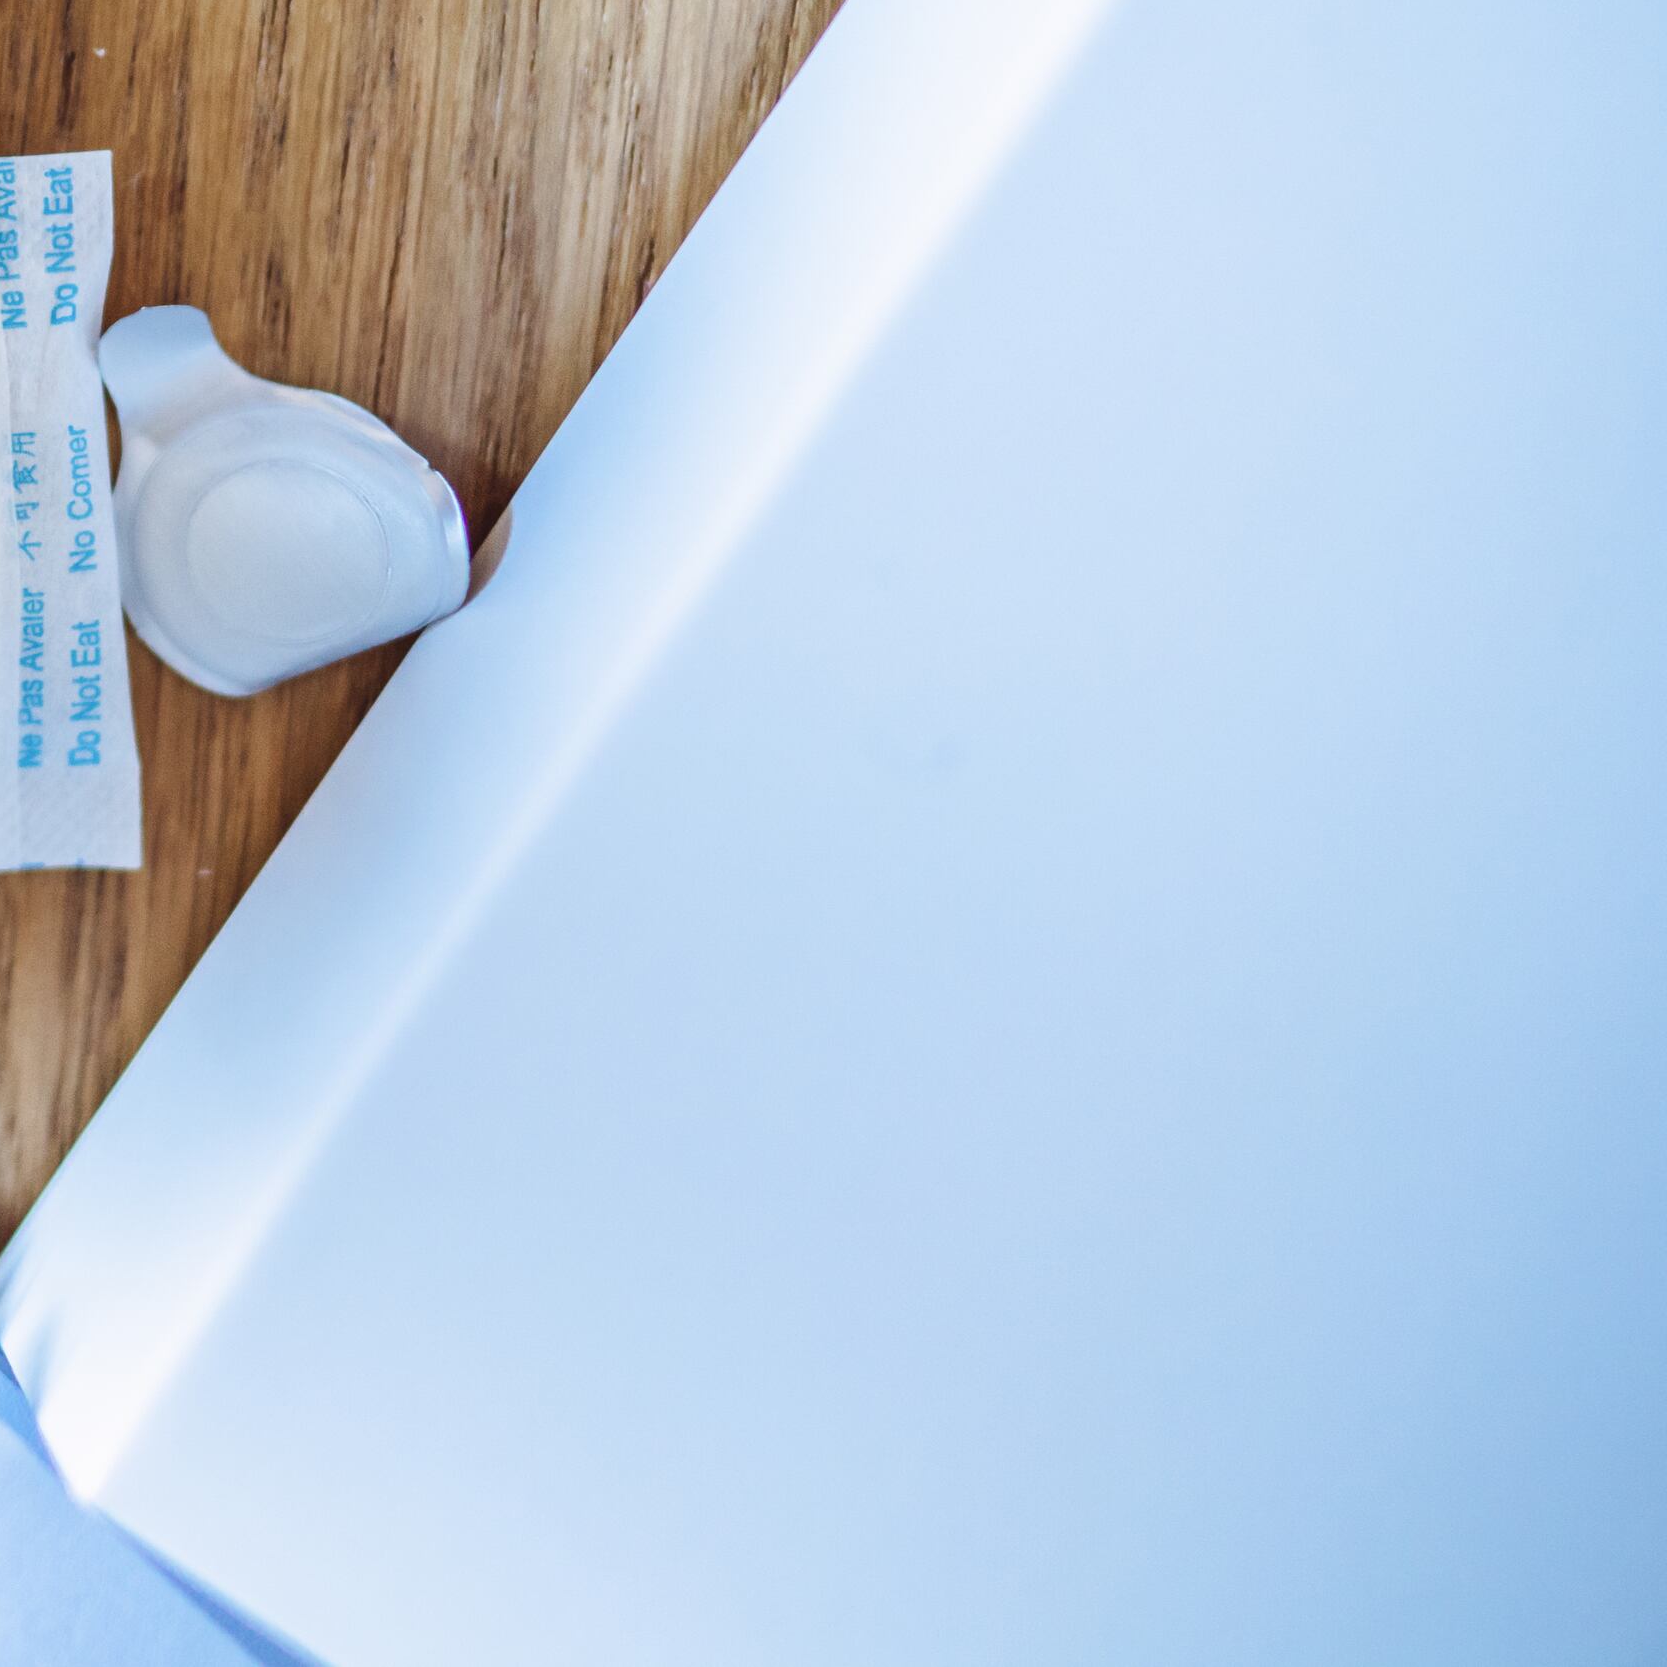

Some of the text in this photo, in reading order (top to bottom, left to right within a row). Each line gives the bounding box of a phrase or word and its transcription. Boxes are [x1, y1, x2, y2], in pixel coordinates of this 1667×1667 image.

[0, 290, 28, 331] Ne
[42, 165, 80, 327] Do Not Eat
[17, 586, 44, 769] Ne Pas Avaler
[65, 423, 103, 767] Do Not Eat No Comer
